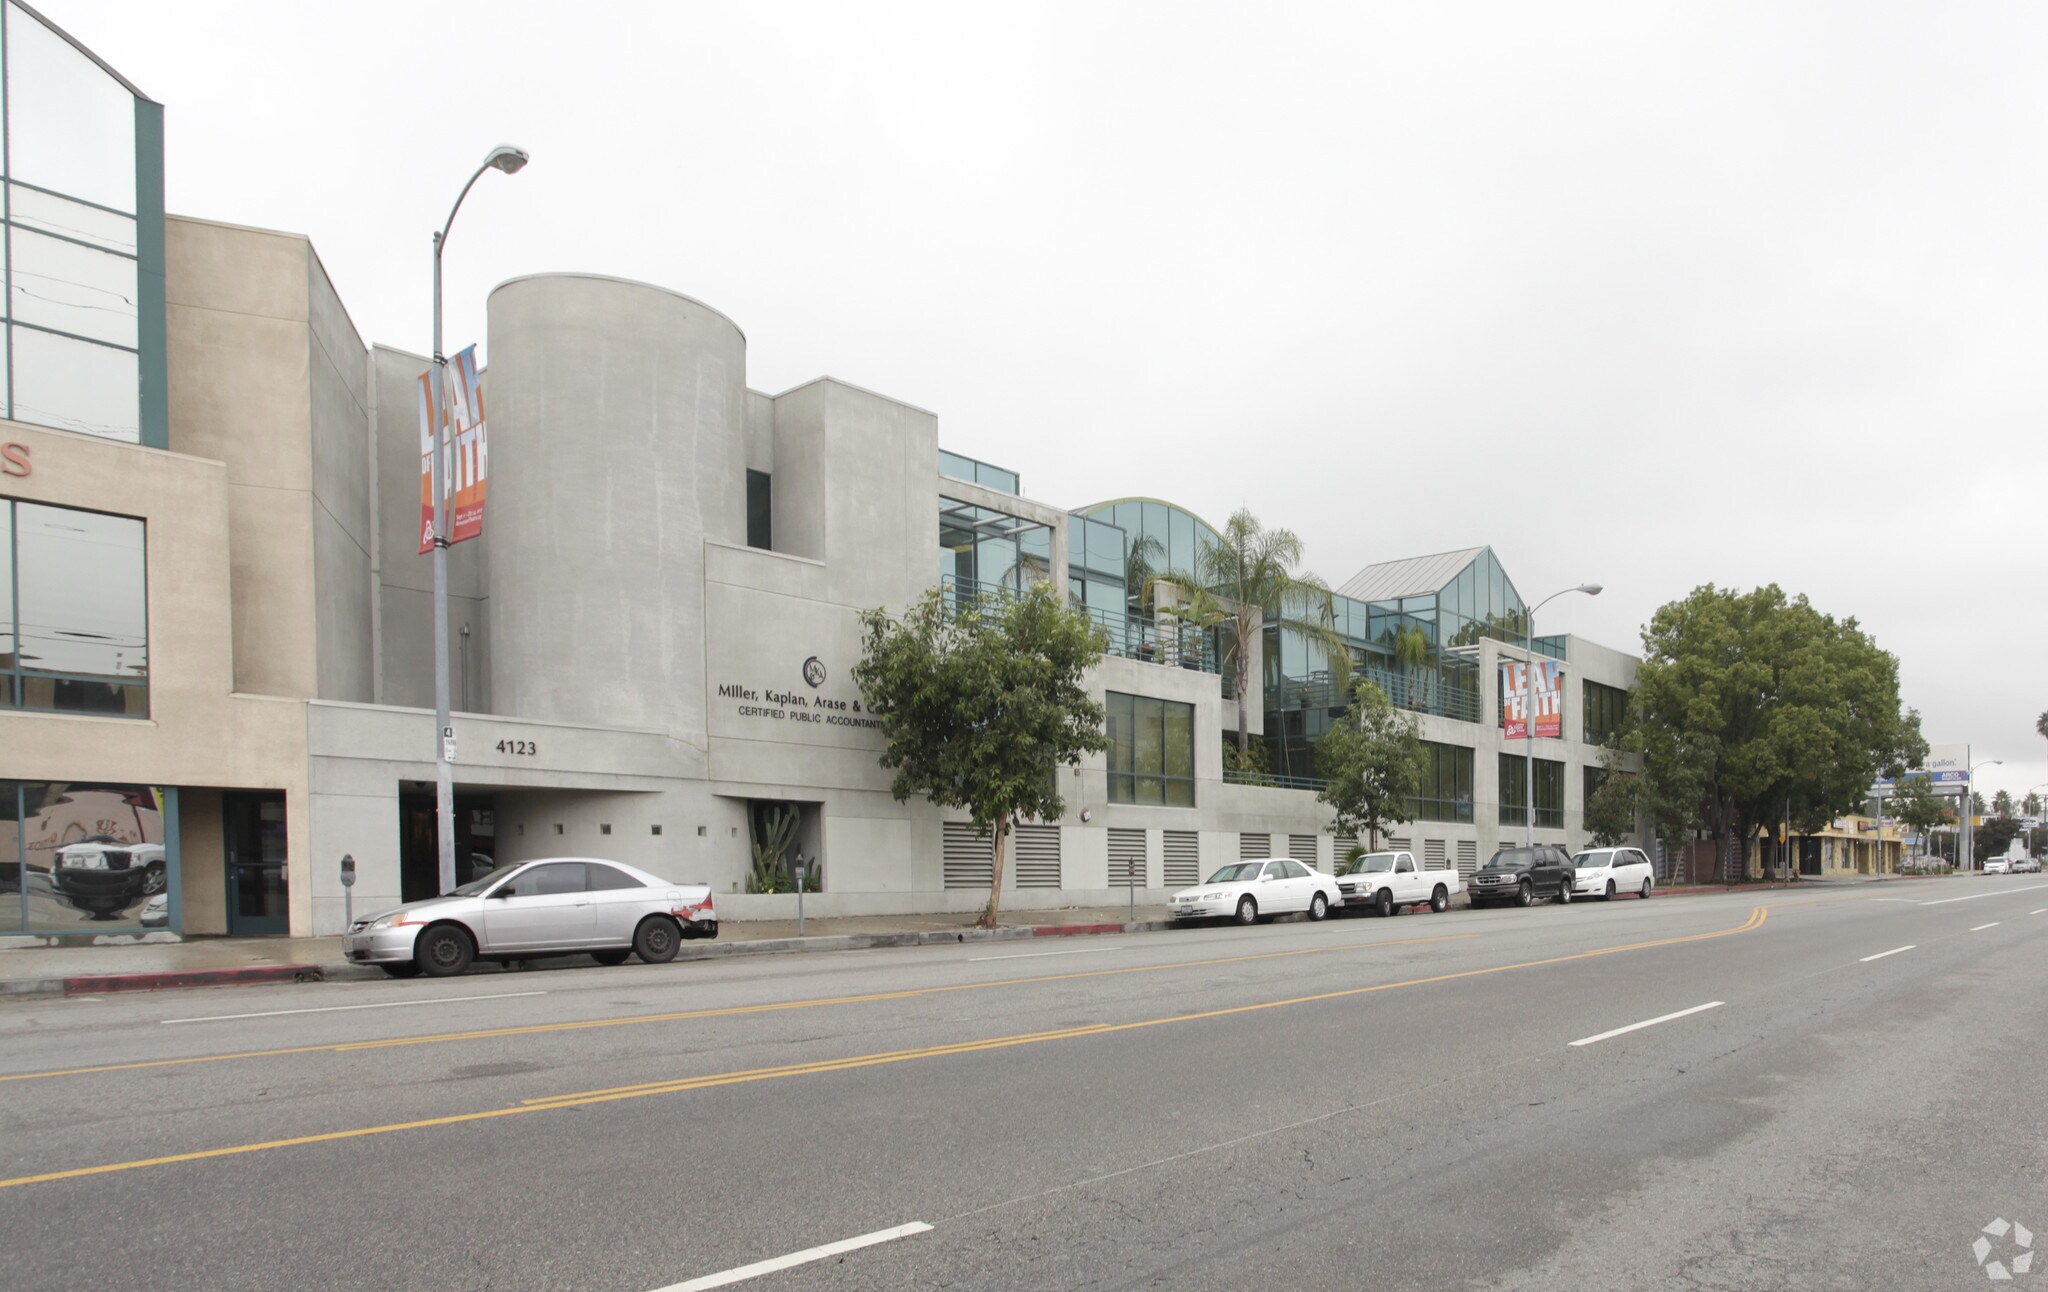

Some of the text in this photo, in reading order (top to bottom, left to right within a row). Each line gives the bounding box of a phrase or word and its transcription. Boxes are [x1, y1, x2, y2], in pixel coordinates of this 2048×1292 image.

[765, 690, 808, 707] Kaplan,
[814, 696, 847, 711] Arase
[852, 700, 861, 712] &
[738, 706, 881, 729] CERTIFIED PUBLIC ACCOUNTANT
[496, 739, 537, 756] 4123
